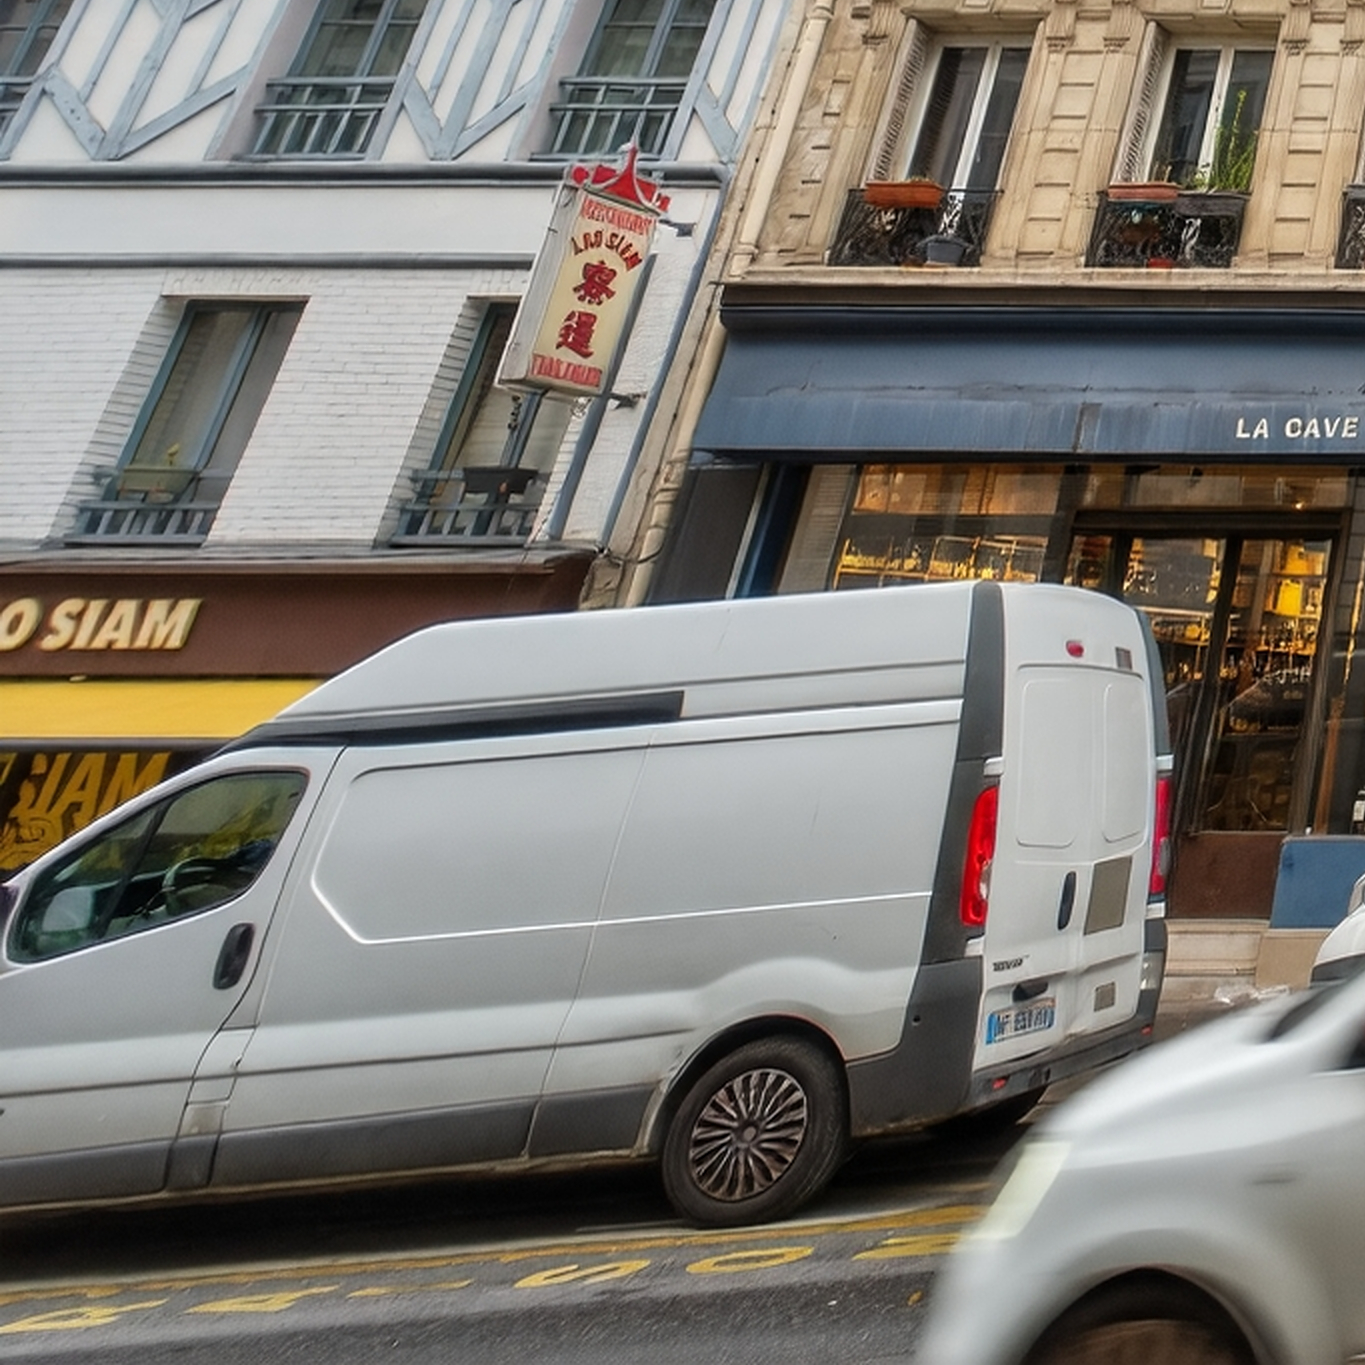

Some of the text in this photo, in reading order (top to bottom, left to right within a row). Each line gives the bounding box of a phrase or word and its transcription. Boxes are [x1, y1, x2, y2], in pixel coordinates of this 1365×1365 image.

[1235, 417, 1270, 439] LA
[1284, 416, 1359, 439] CAVE
[39, 597, 204, 652] SIAM
